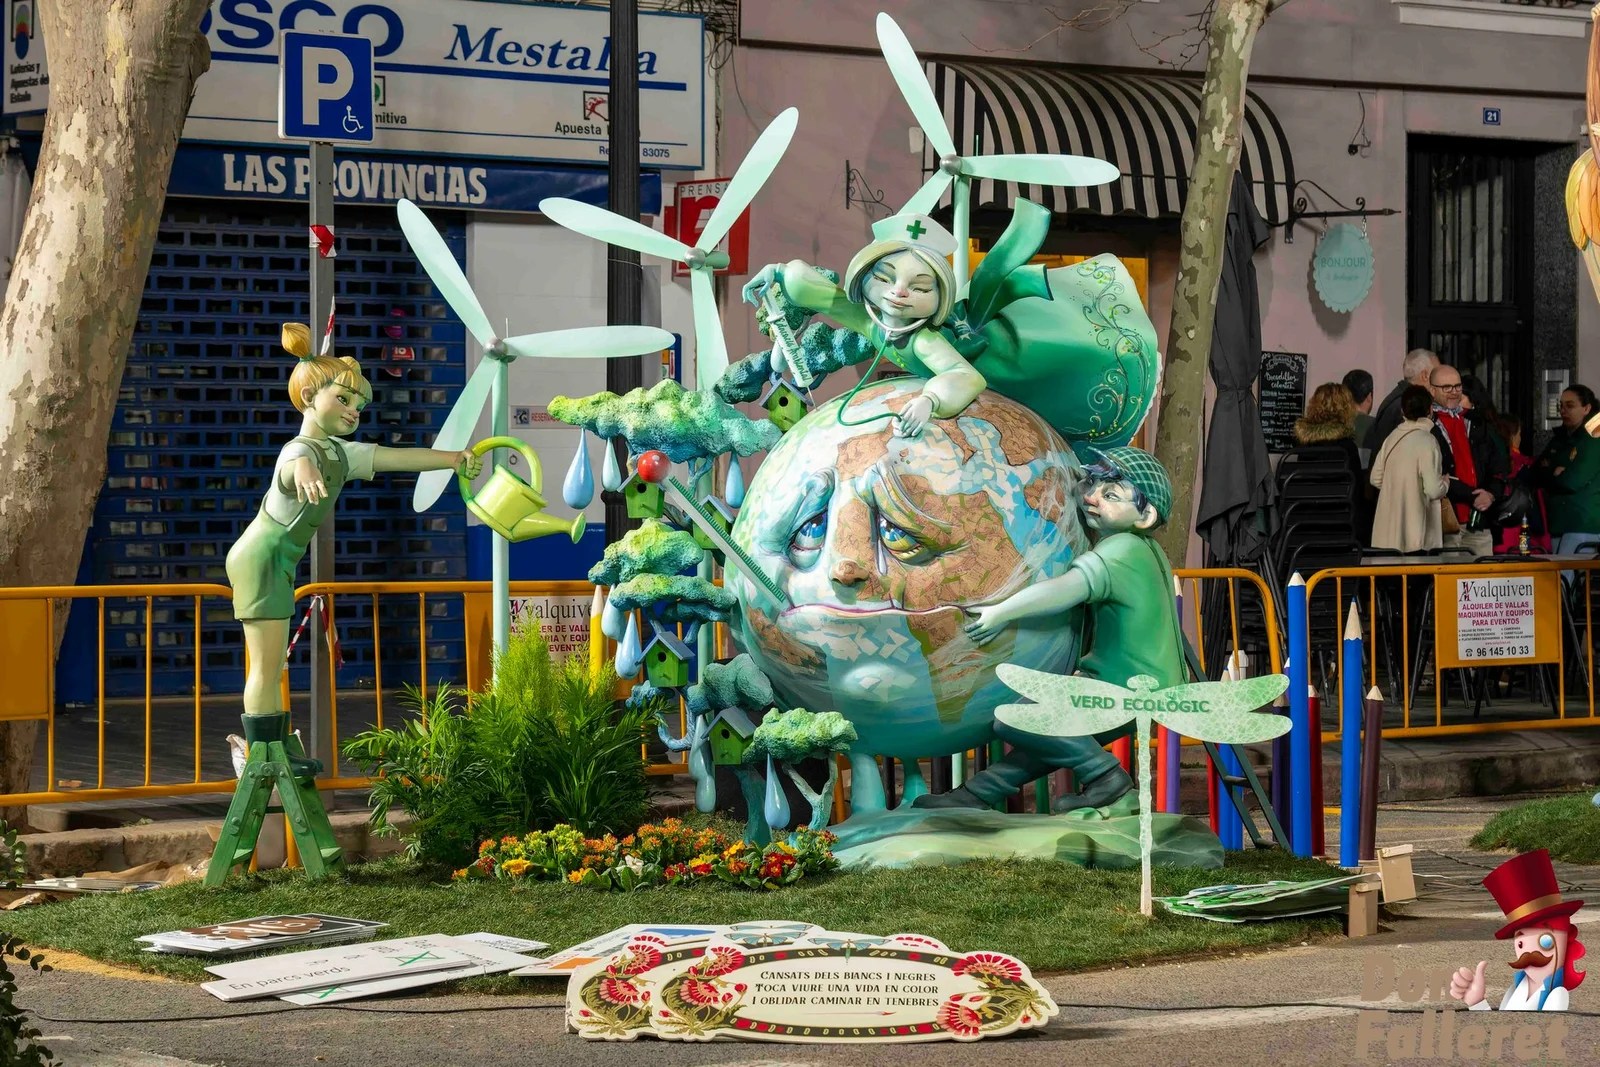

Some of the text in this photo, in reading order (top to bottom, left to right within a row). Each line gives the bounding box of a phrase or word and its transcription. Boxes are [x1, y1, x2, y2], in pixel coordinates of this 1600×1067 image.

[197, 0, 406, 58] SCO
[444, 24, 658, 75] Mestala
[302, 46, 355, 126] P
[1487, 111, 1497, 121] 21
[554, 121, 602, 136] Apuesta
[642, 147, 670, 158] 83075
[223, 153, 488, 205] LAS POVINCIAS
[1320, 256, 1366, 268] BONJOUR
[1473, 580, 1533, 601] valquiven
[1462, 602, 1494, 611] ALQUILER
[1504, 601, 1529, 609] VALLAS
[1458, 610, 1498, 618] MAQUINARIA
[1505, 609, 1534, 617] EQUIPOS
[555, 625, 566, 633] DE
[569, 624, 590, 632] VALL
[1472, 618, 1520, 627] PARA EVENTOS
[561, 634, 567, 642] Y
[1476, 645, 1529, 657] 96 145 10 33
[1070, 694, 1115, 710] VERD
[229, 965, 351, 991] En parcs verds
[760, 970, 810, 980] CANSATS
[814, 971, 840, 980] DELS
[886, 972, 890, 981] I
[894, 972, 936, 982] NEGRES
[754, 983, 939, 994] TOCA VIURE UNA VIDA EN COLOR
[752, 996, 939, 1007] I OBLIDAR CAMINAR EN TENEBRES
